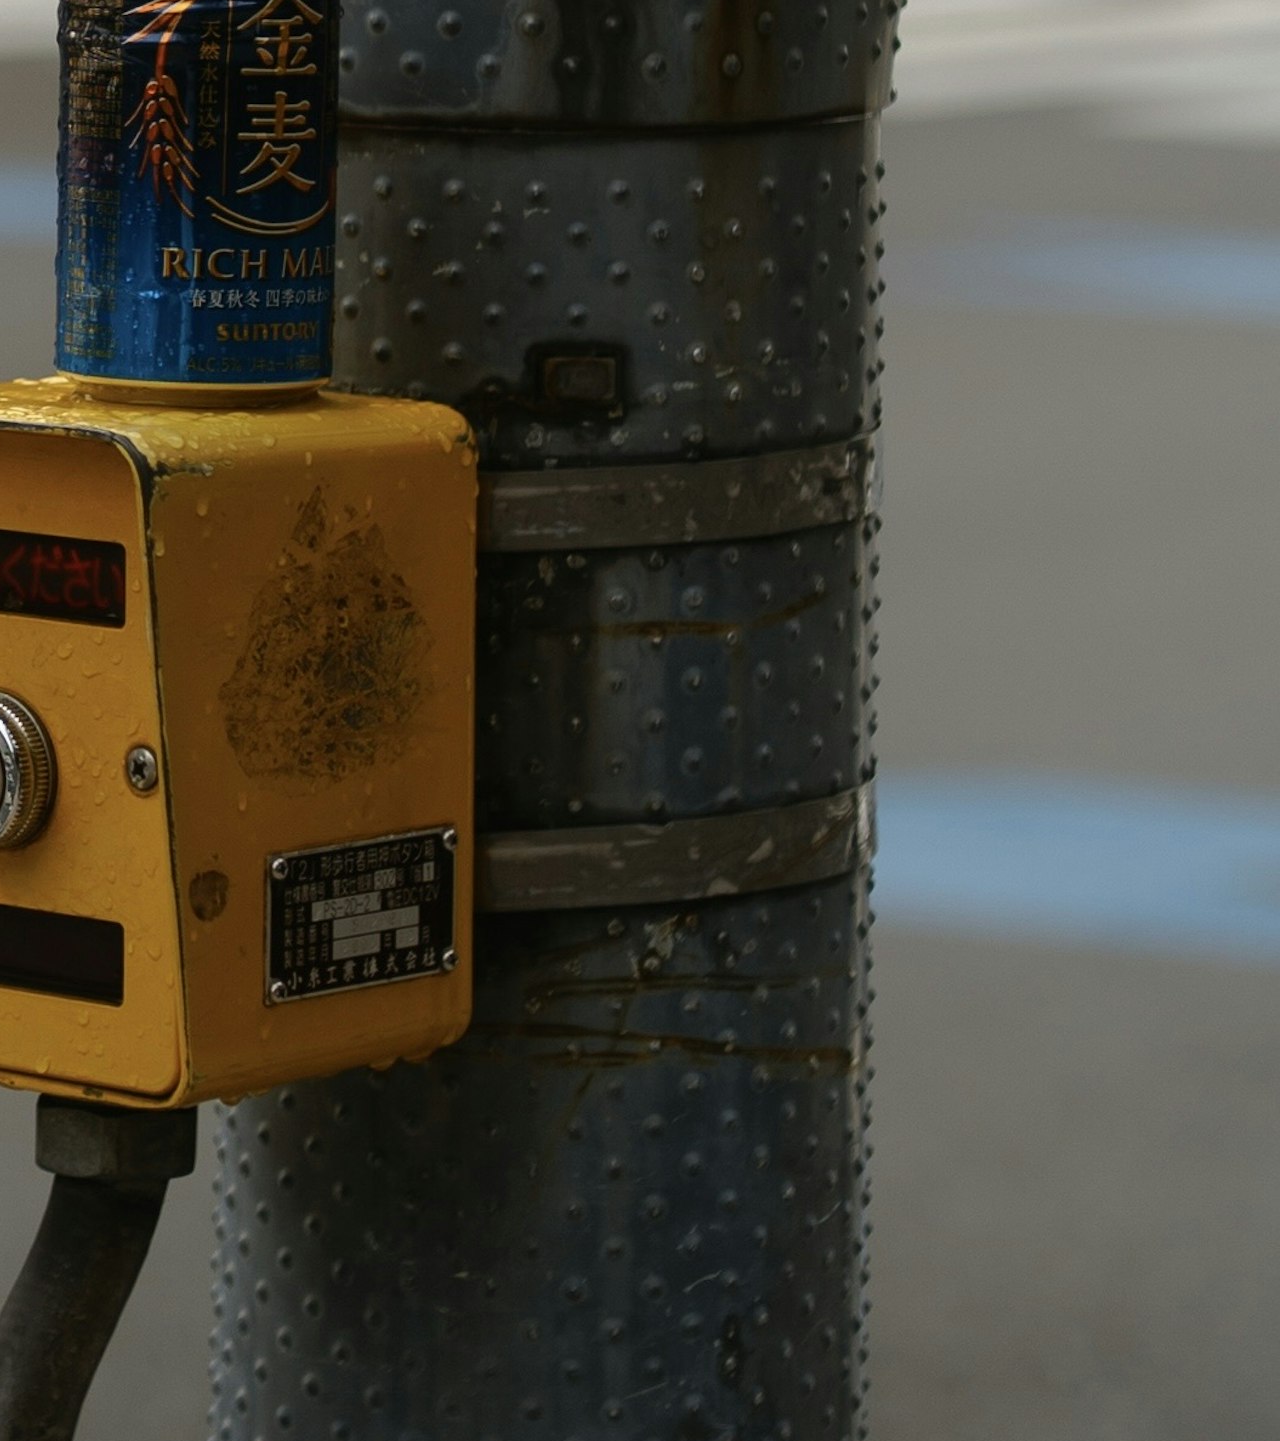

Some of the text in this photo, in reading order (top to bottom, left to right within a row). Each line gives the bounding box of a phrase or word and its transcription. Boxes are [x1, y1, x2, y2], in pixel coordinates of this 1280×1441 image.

[198, 20, 222, 149] 天然水仕込み
[161, 247, 269, 280] RICH
[190, 288, 261, 309] 春夏秋冬
